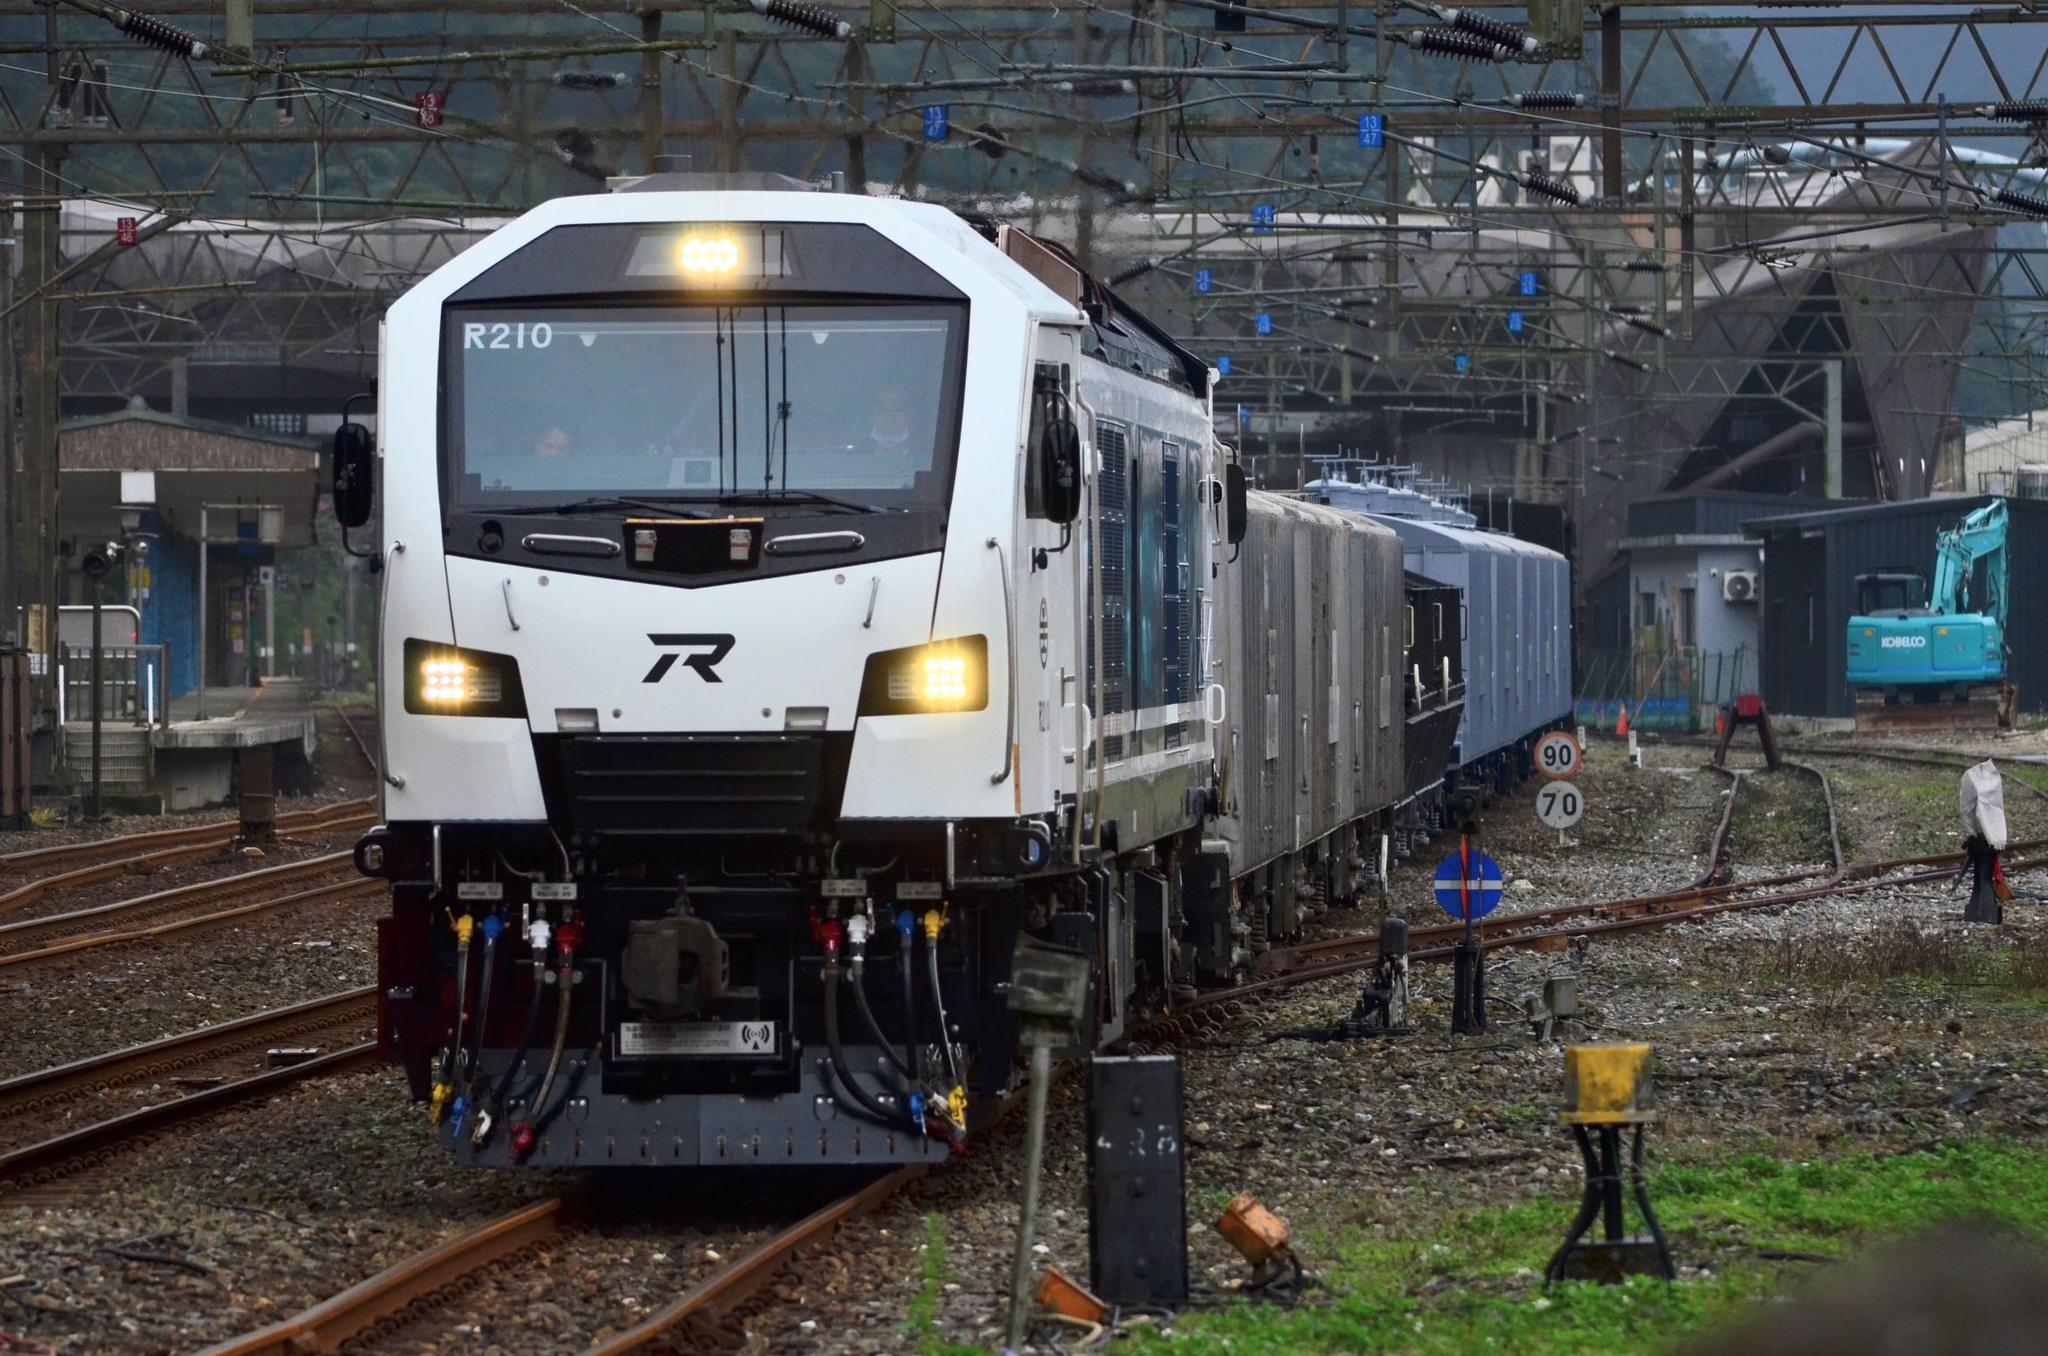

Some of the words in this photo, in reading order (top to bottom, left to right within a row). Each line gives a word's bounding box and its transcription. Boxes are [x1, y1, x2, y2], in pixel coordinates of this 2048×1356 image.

[928, 105, 942, 120] 13
[1364, 115, 1377, 129] 13
[1362, 132, 1377, 145] 47
[122, 219, 132, 229] 13
[121, 232, 133, 243] 46
[463, 322, 553, 349] R210
[1881, 636, 1926, 648] KOBELCO
[1543, 745, 1571, 767] 90
[1542, 792, 1577, 817] 70
